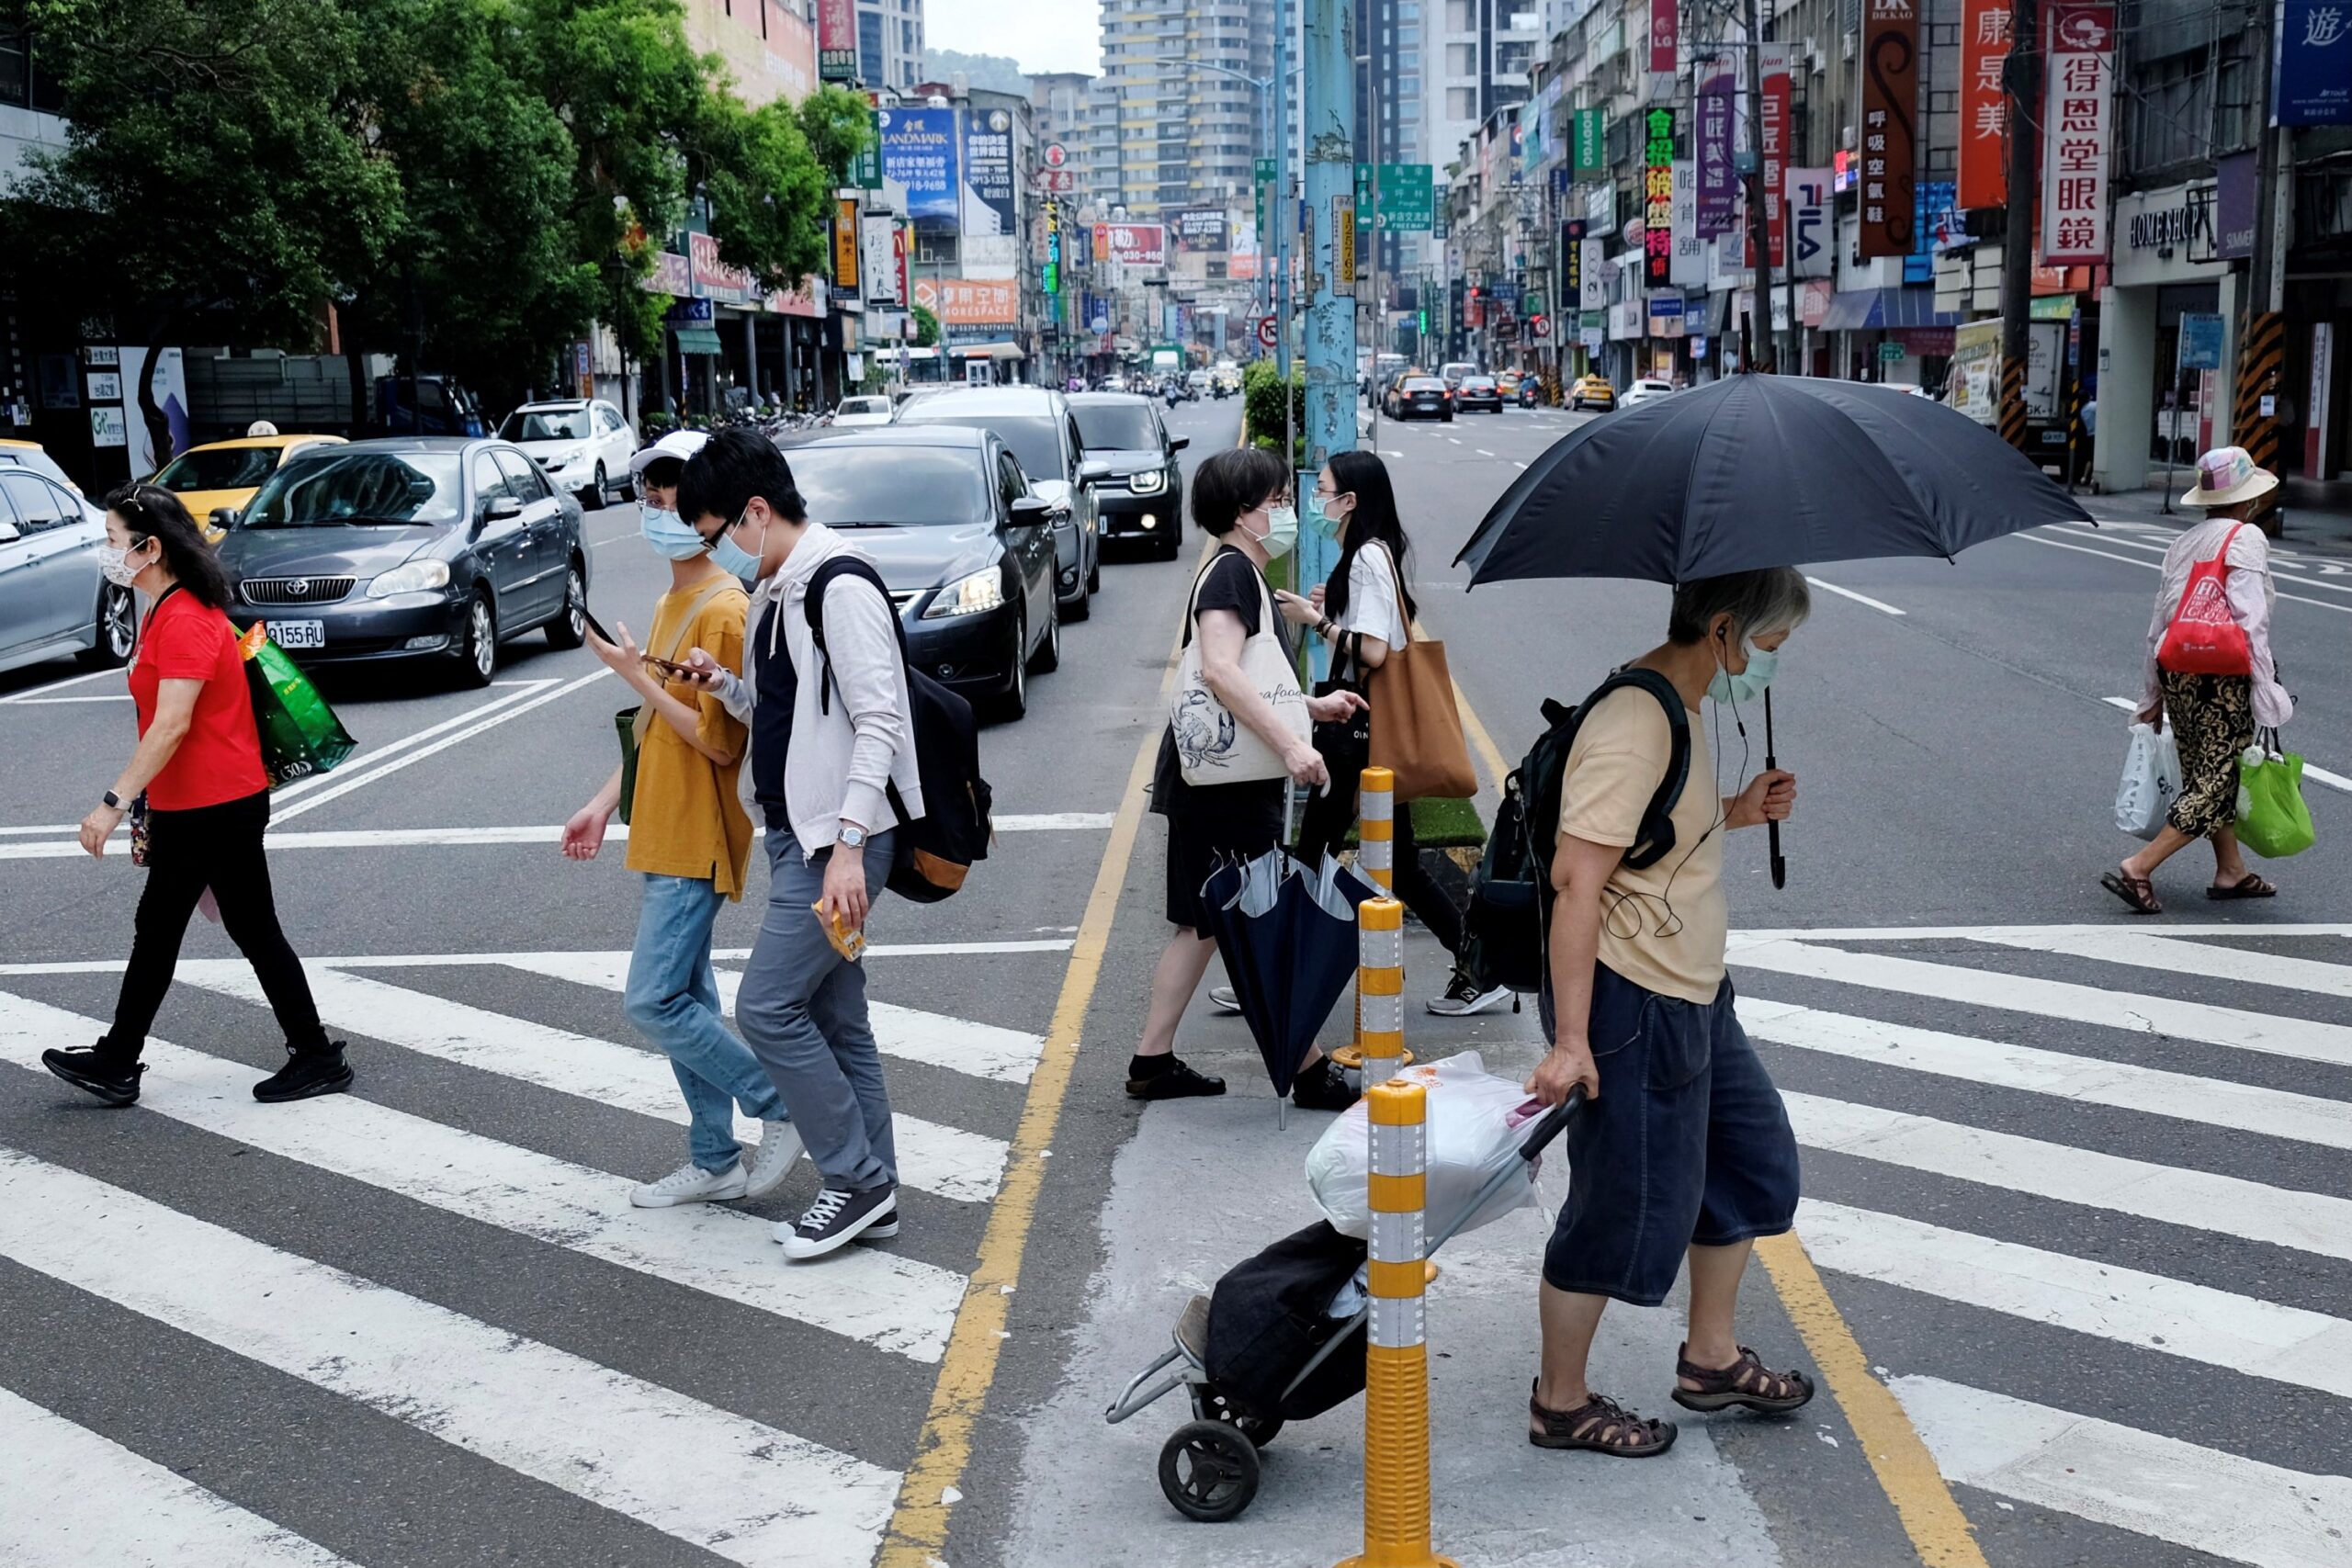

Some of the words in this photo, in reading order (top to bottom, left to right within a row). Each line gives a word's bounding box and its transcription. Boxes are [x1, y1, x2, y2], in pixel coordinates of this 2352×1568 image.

[1655, 36, 1672, 47] LG
[1872, 11, 1913, 19] DR.KAO
[2301, 7, 2346, 46] 遊
[1975, 7, 2012, 140] 康是美
[882, 133, 948, 144] LANDMARK
[1583, 111, 1592, 166] BODYGO
[1705, 96, 1724, 187] 巨匠美語
[1867, 110, 1887, 223] 呼吸空氣鞋
[2057, 58, 2100, 250] 得恩堂眼鏡
[1388, 212, 1430, 222] 新店交流道
[1679, 169, 1701, 256] 哈肯舖
[1797, 185, 1822, 261] FILA
[2131, 211, 2164, 246] HOME
[2165, 206, 2199, 243] SHOP
[1344, 214, 1353, 280] 125762
